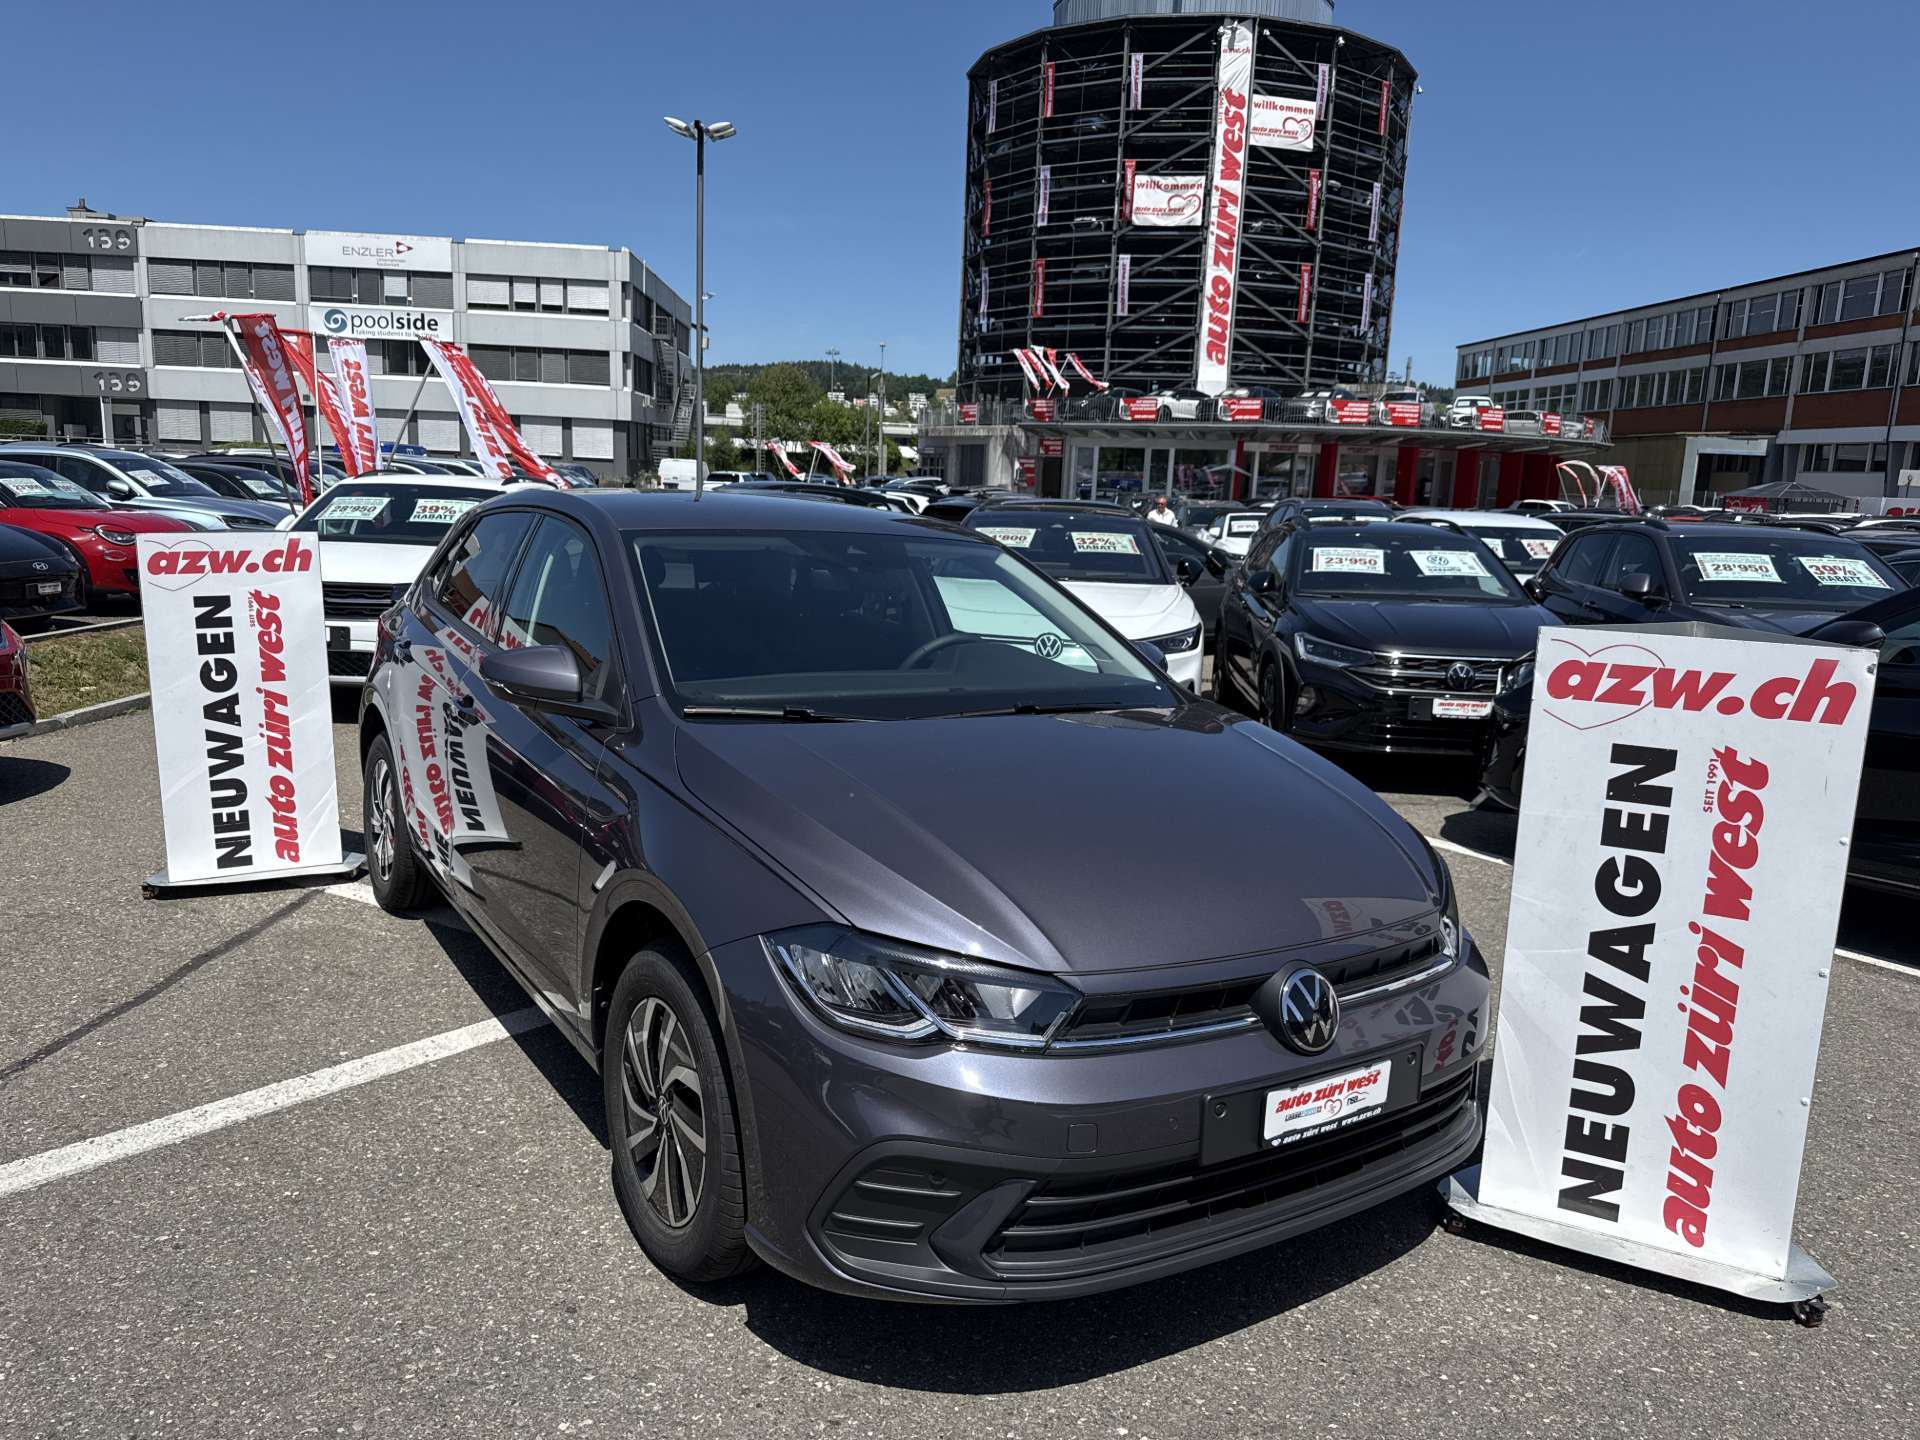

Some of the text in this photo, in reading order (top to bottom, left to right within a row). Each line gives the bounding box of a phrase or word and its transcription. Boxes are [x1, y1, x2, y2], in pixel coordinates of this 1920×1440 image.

[1253, 101, 1314, 115] willkommen
[1136, 180, 1203, 190] willkommen
[1206, 87, 1246, 366] auto züri west
[342, 246, 394, 257] ENZLER
[351, 312, 439, 334] poolside
[377, 330, 402, 338] students
[341, 359, 370, 418] west
[416, 505, 457, 516] 39%
[1076, 537, 1116, 546] 32%
[147, 538, 312, 575] azw.ch
[1324, 557, 1378, 566] 23'950
[1711, 563, 1770, 573] 28'950
[1808, 564, 1857, 577] 39%
[1817, 575, 1864, 584] RABATT
[1546, 657, 1857, 726] azw.ch
[193, 595, 253, 869] NEUWAGEN
[254, 589, 300, 863] auto züri west
[1703, 757, 1720, 813] SEIT 1991
[1557, 743, 1678, 1223] NEUWAGEN
[1662, 746, 1769, 1248] auto züri west
[1275, 1070, 1381, 1114] auto züri west
[1320, 1121, 1338, 1134] west
